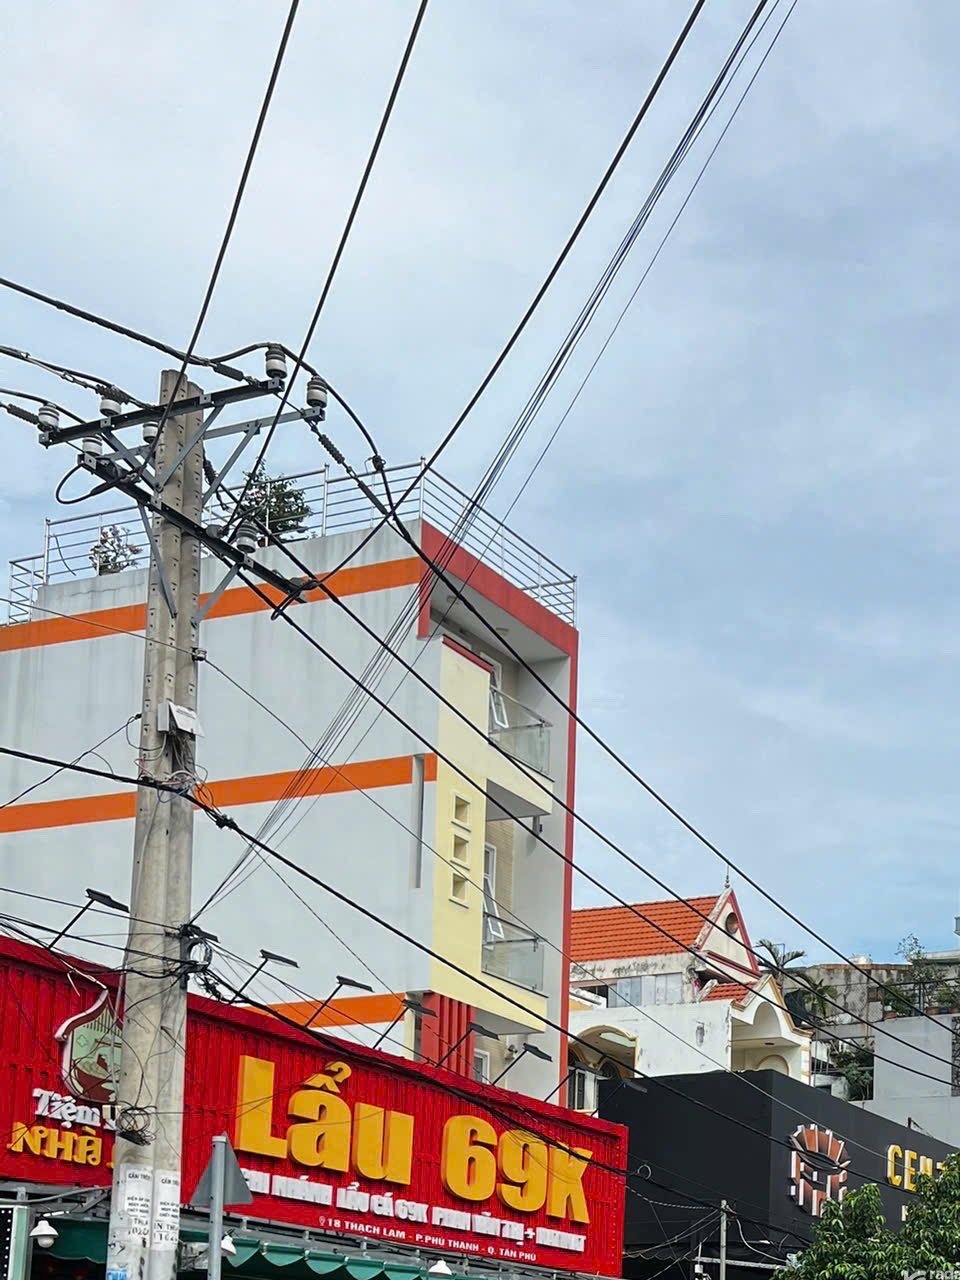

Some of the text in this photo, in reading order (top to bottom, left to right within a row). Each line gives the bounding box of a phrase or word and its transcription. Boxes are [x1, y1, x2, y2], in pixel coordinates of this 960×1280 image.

[33, 1088, 101, 1128] Tiệm
[234, 1055, 414, 1187] Lẩu
[6, 1121, 102, 1166] NHÀ
[327, 1218, 341, 1228] 18
[382, 1227, 406, 1240] LAM
